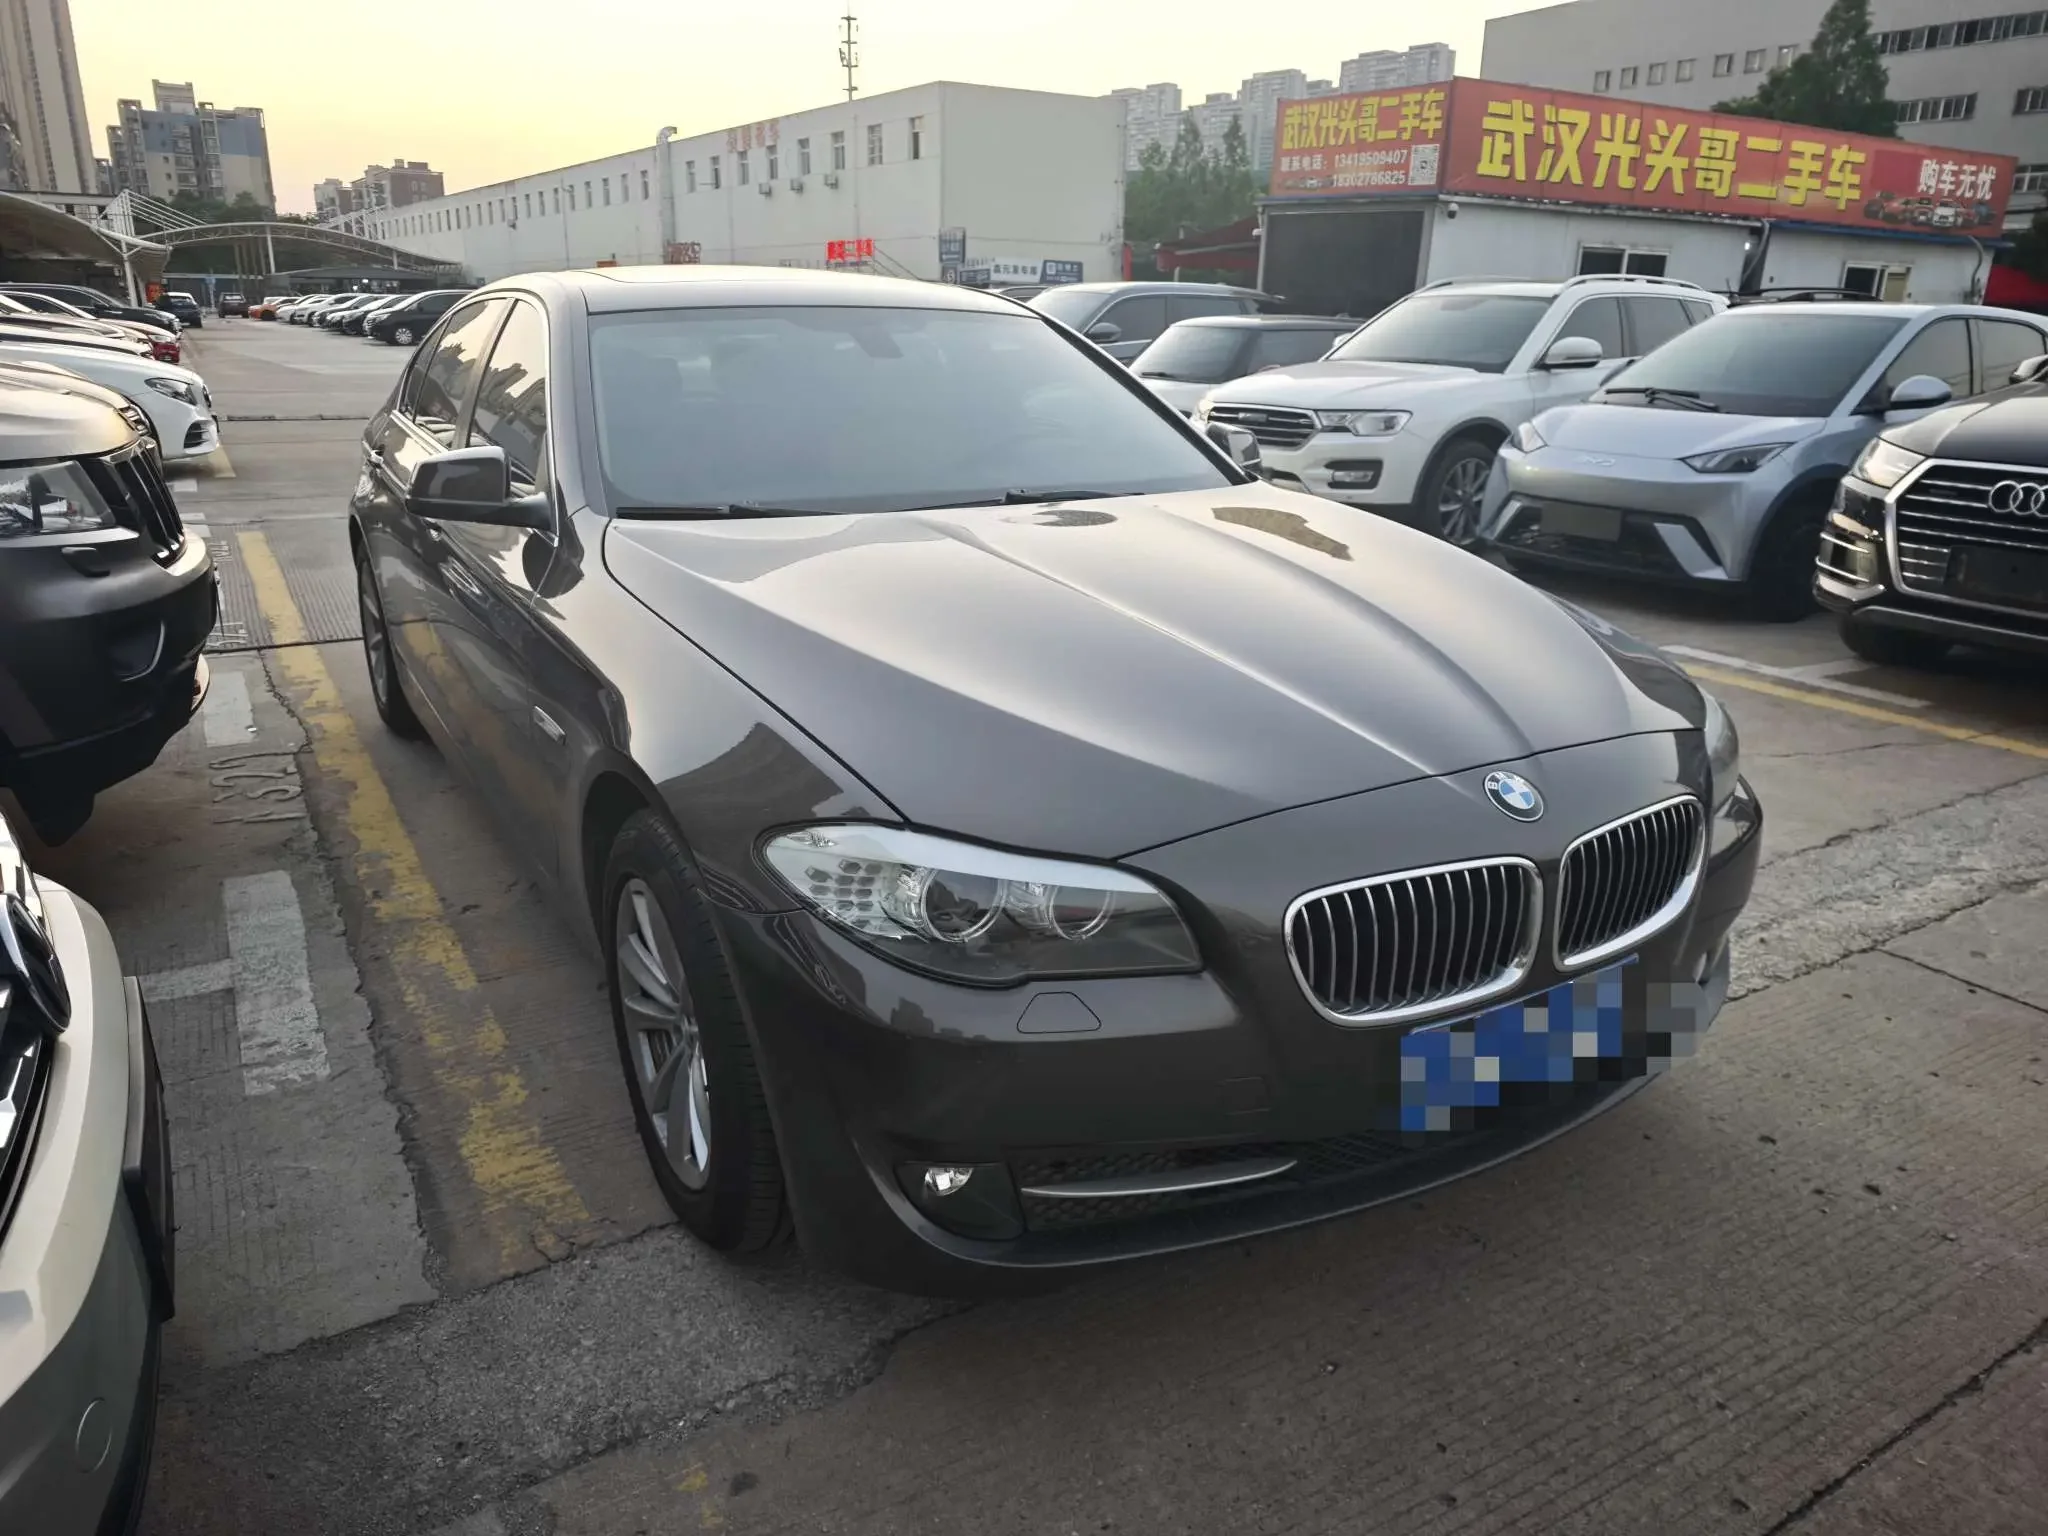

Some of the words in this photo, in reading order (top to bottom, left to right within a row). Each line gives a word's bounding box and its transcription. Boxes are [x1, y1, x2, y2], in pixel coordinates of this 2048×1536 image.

[1282, 88, 1446, 150] 武汉光头哥二手车
[1477, 99, 1867, 211] 武汉光头哥二手车
[1917, 159, 1997, 201] 购车无忧
